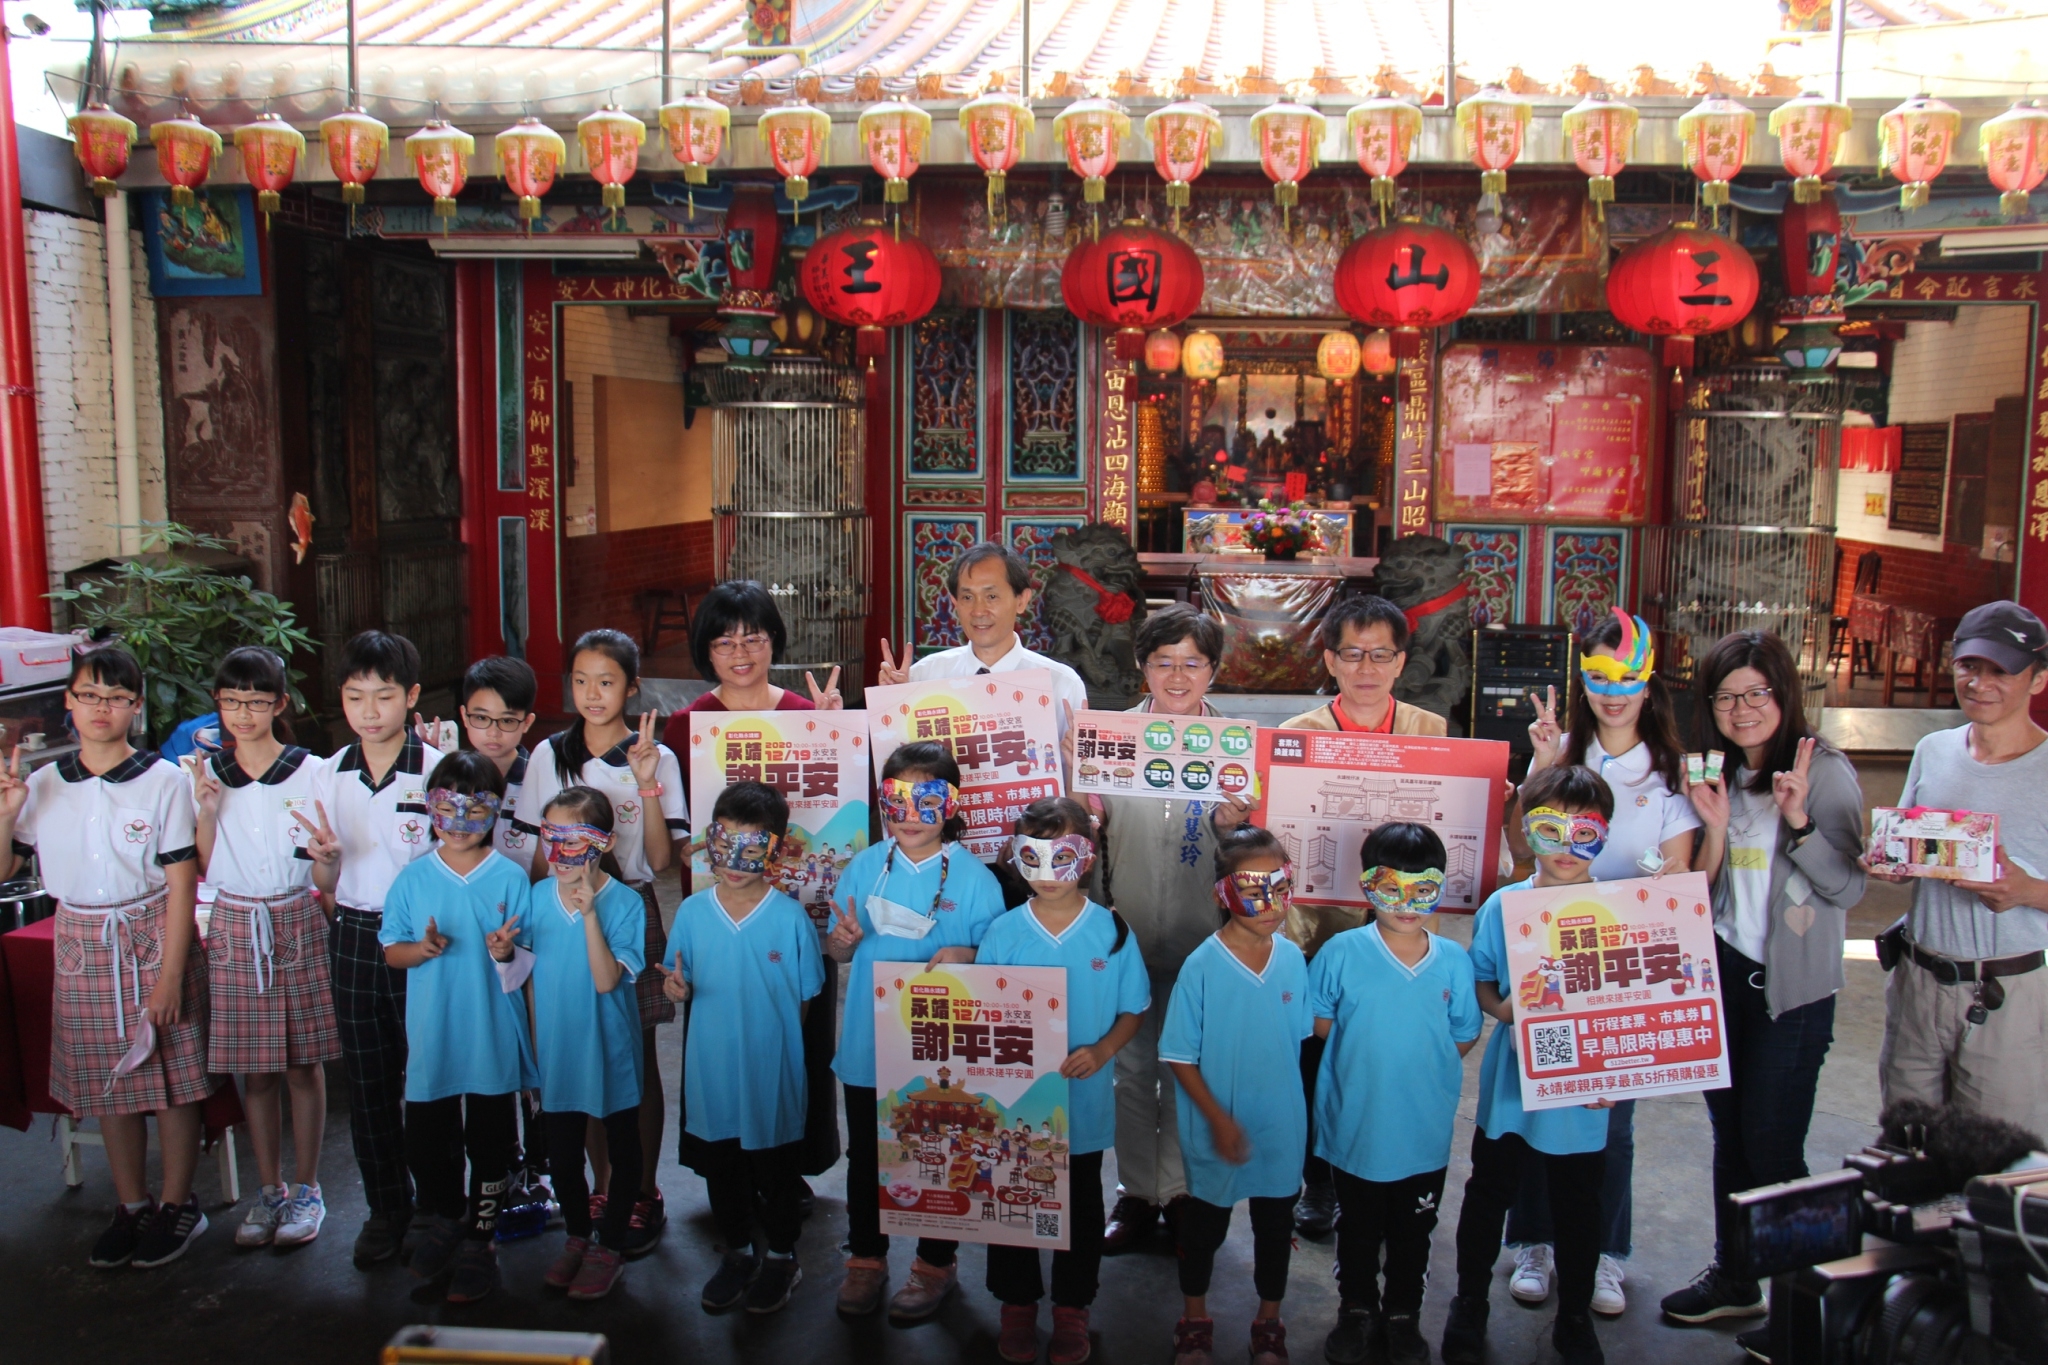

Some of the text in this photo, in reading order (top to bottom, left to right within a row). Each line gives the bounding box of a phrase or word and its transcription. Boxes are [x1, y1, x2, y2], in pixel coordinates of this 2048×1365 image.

[840, 240, 882, 294] 王
[1385, 243, 1450, 291] 山
[1107, 249, 1163, 312] 國
[1678, 250, 1733, 306] 三
[526, 309, 551, 531] 安心有仰聖深深
[917, 717, 951, 738] 永靖
[953, 714, 978, 722] 2020
[953, 720, 997, 734] 12/19
[998, 716, 1022, 726] 永安宮
[726, 742, 762, 761] 永靖
[765, 750, 811, 761] 12/19
[812, 748, 838, 757] 永安宮
[1078, 740, 1136, 760] 謝平安
[1434, 812, 1443, 821] 2
[1305, 884, 1314, 893] 3
[1600, 924, 1628, 933] 2020
[1651, 926, 1677, 938] 永安宮
[1560, 927, 1598, 951] 永靖
[1601, 931, 1649, 947] 12/19
[1562, 943, 1684, 995] 謝平安
[911, 997, 949, 1020] 永靖
[953, 999, 982, 1008] 2020
[952, 1009, 1002, 1022] 12/19
[1004, 1009, 1032, 1020] 永安宮
[1592, 1007, 1699, 1033] 行程套票、市集券
[911, 1020, 1033, 1066] 謝平安
[1582, 1026, 1713, 1058] 早鳥限時優惠中
[1536, 1063, 1720, 1097] 永靖鄉親再享最高5折預購優惠
